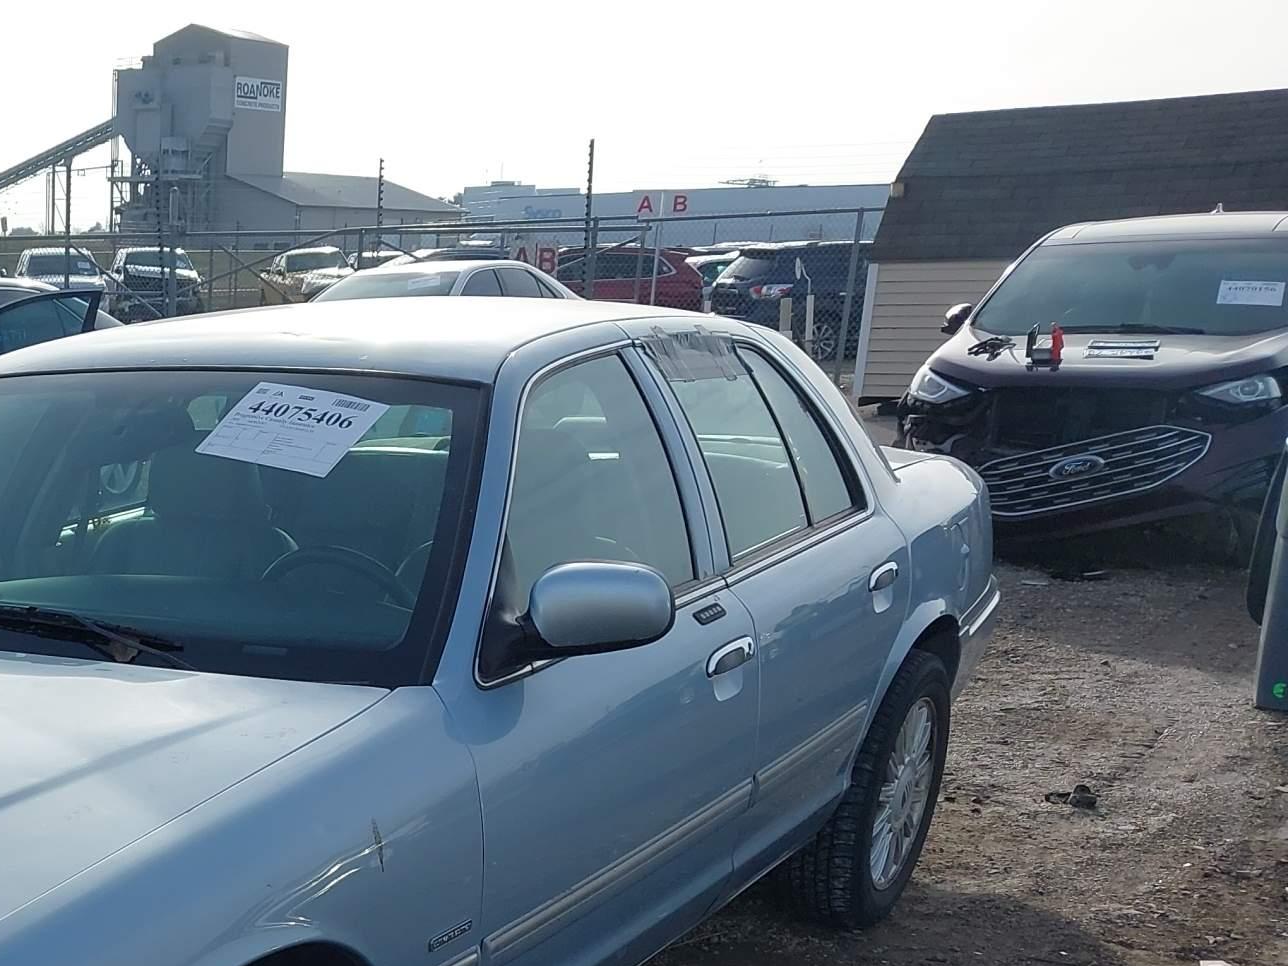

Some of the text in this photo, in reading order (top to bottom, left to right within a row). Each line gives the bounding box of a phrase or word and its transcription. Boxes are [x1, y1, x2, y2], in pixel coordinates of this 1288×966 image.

[236, 81, 281, 99] ROANOKE
[638, 195, 688, 213] A B
[538, 247, 557, 273] B
[248, 401, 360, 430] 44075406
[1063, 462, 1092, 475] Ford
